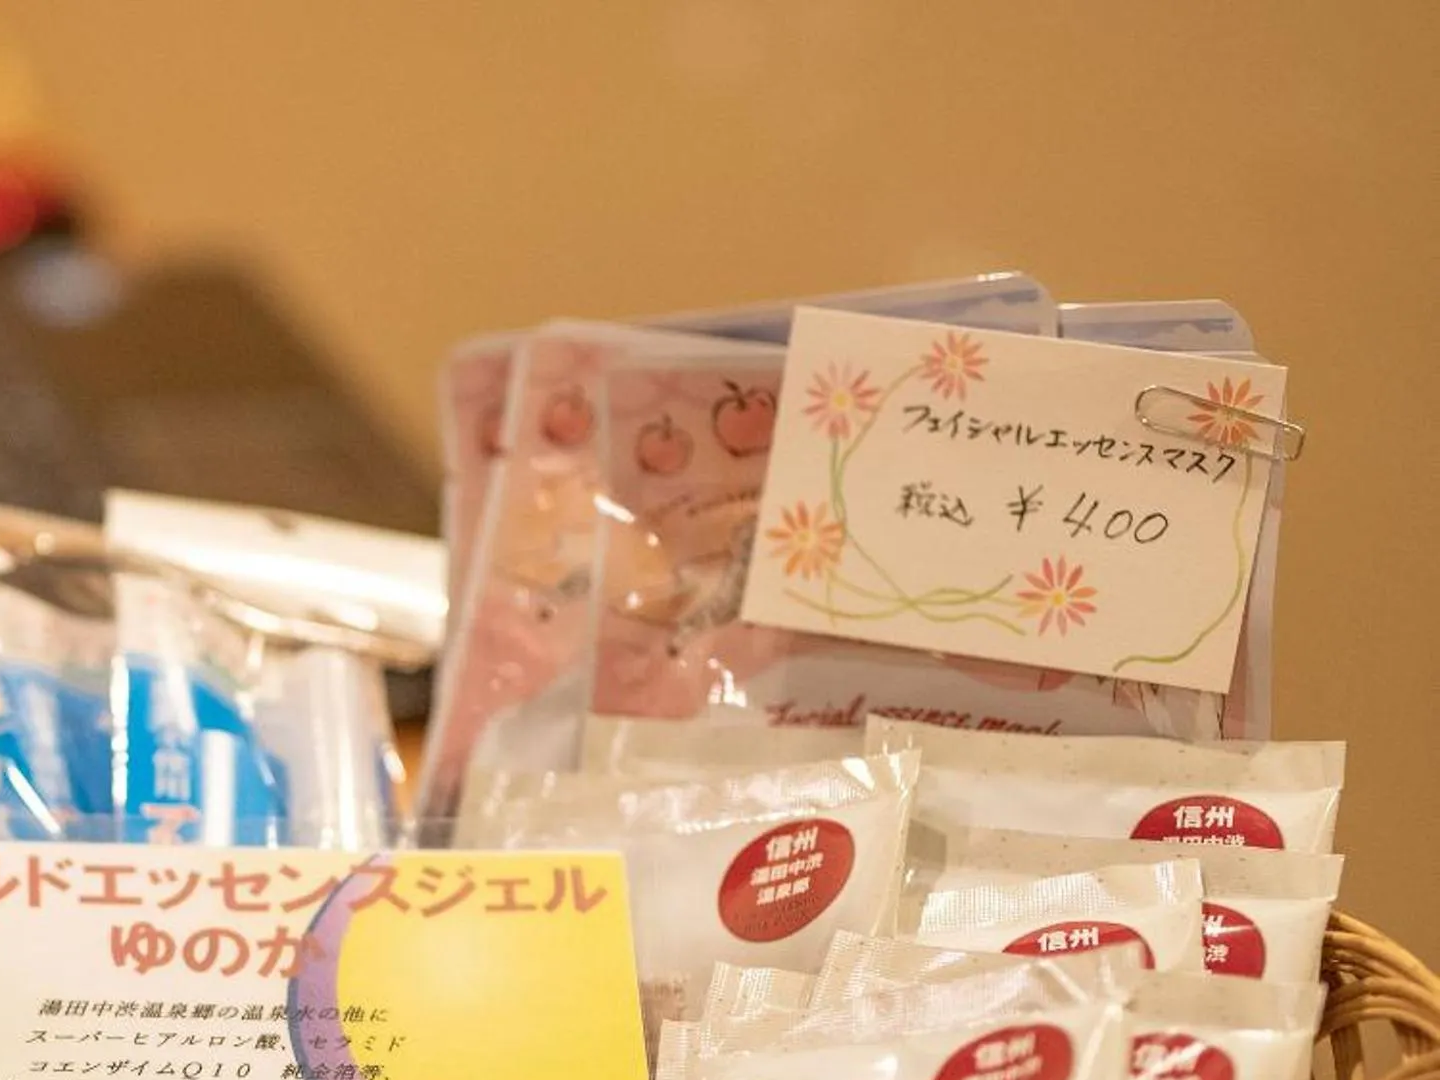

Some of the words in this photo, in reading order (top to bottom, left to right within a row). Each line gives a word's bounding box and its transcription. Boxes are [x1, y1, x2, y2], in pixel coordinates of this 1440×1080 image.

[896, 480, 974, 528] 税込
[1172, 804, 1235, 829] 信州
[765, 826, 819, 862] 信州
[110, 921, 327, 977] ゆのか
[1036, 926, 1100, 953] 信州
